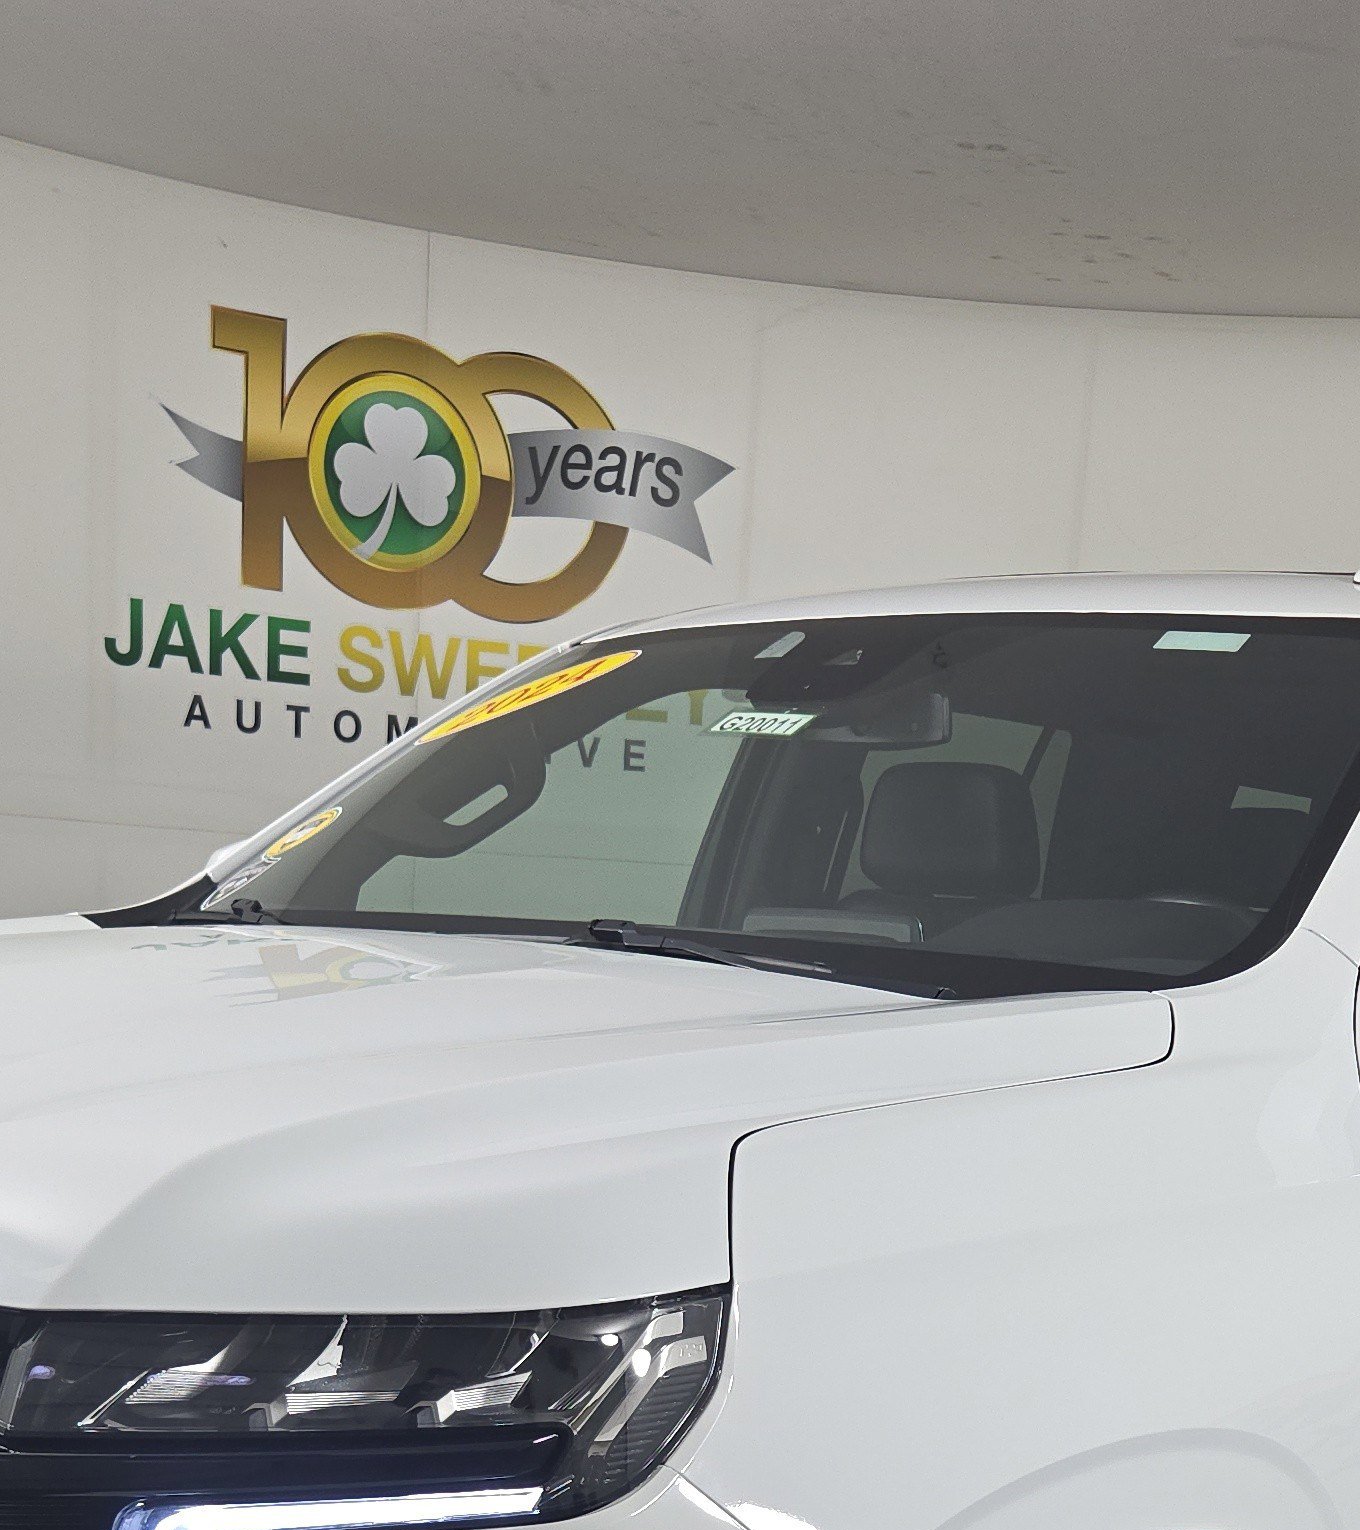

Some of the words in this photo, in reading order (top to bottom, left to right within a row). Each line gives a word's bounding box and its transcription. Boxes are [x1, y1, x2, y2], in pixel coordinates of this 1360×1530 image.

[211, 304, 630, 624] 100
[525, 438, 684, 508] years
[104, 597, 311, 686] JAKE
[719, 716, 802, 734] G20011
